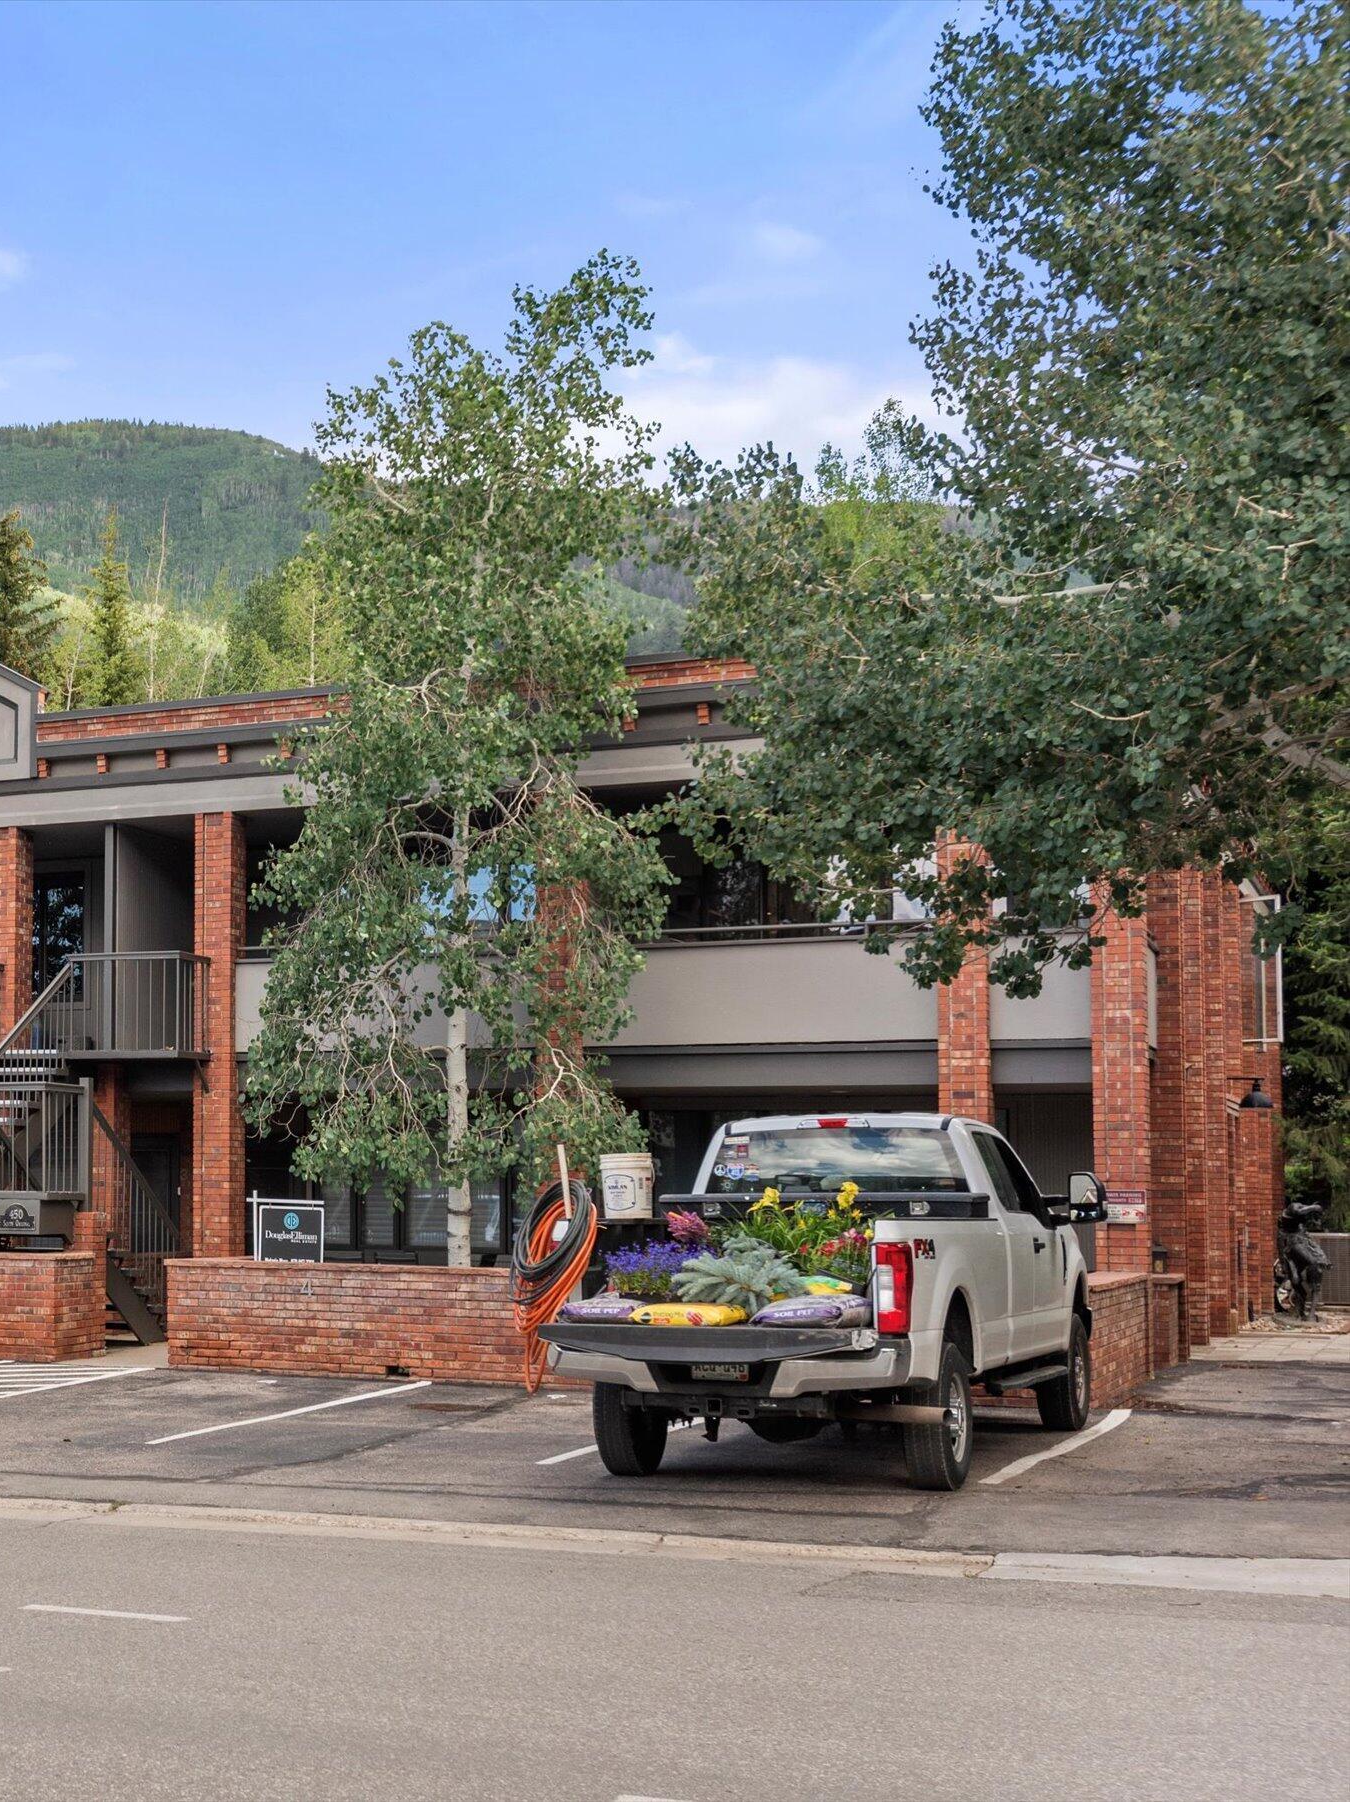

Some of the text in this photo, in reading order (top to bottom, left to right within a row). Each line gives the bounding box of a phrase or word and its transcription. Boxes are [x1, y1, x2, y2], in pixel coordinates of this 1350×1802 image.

[9, 1209, 24, 1219] 450
[300, 1279, 314, 1296] 4
[774, 1308, 815, 1318] SOIL PEP
